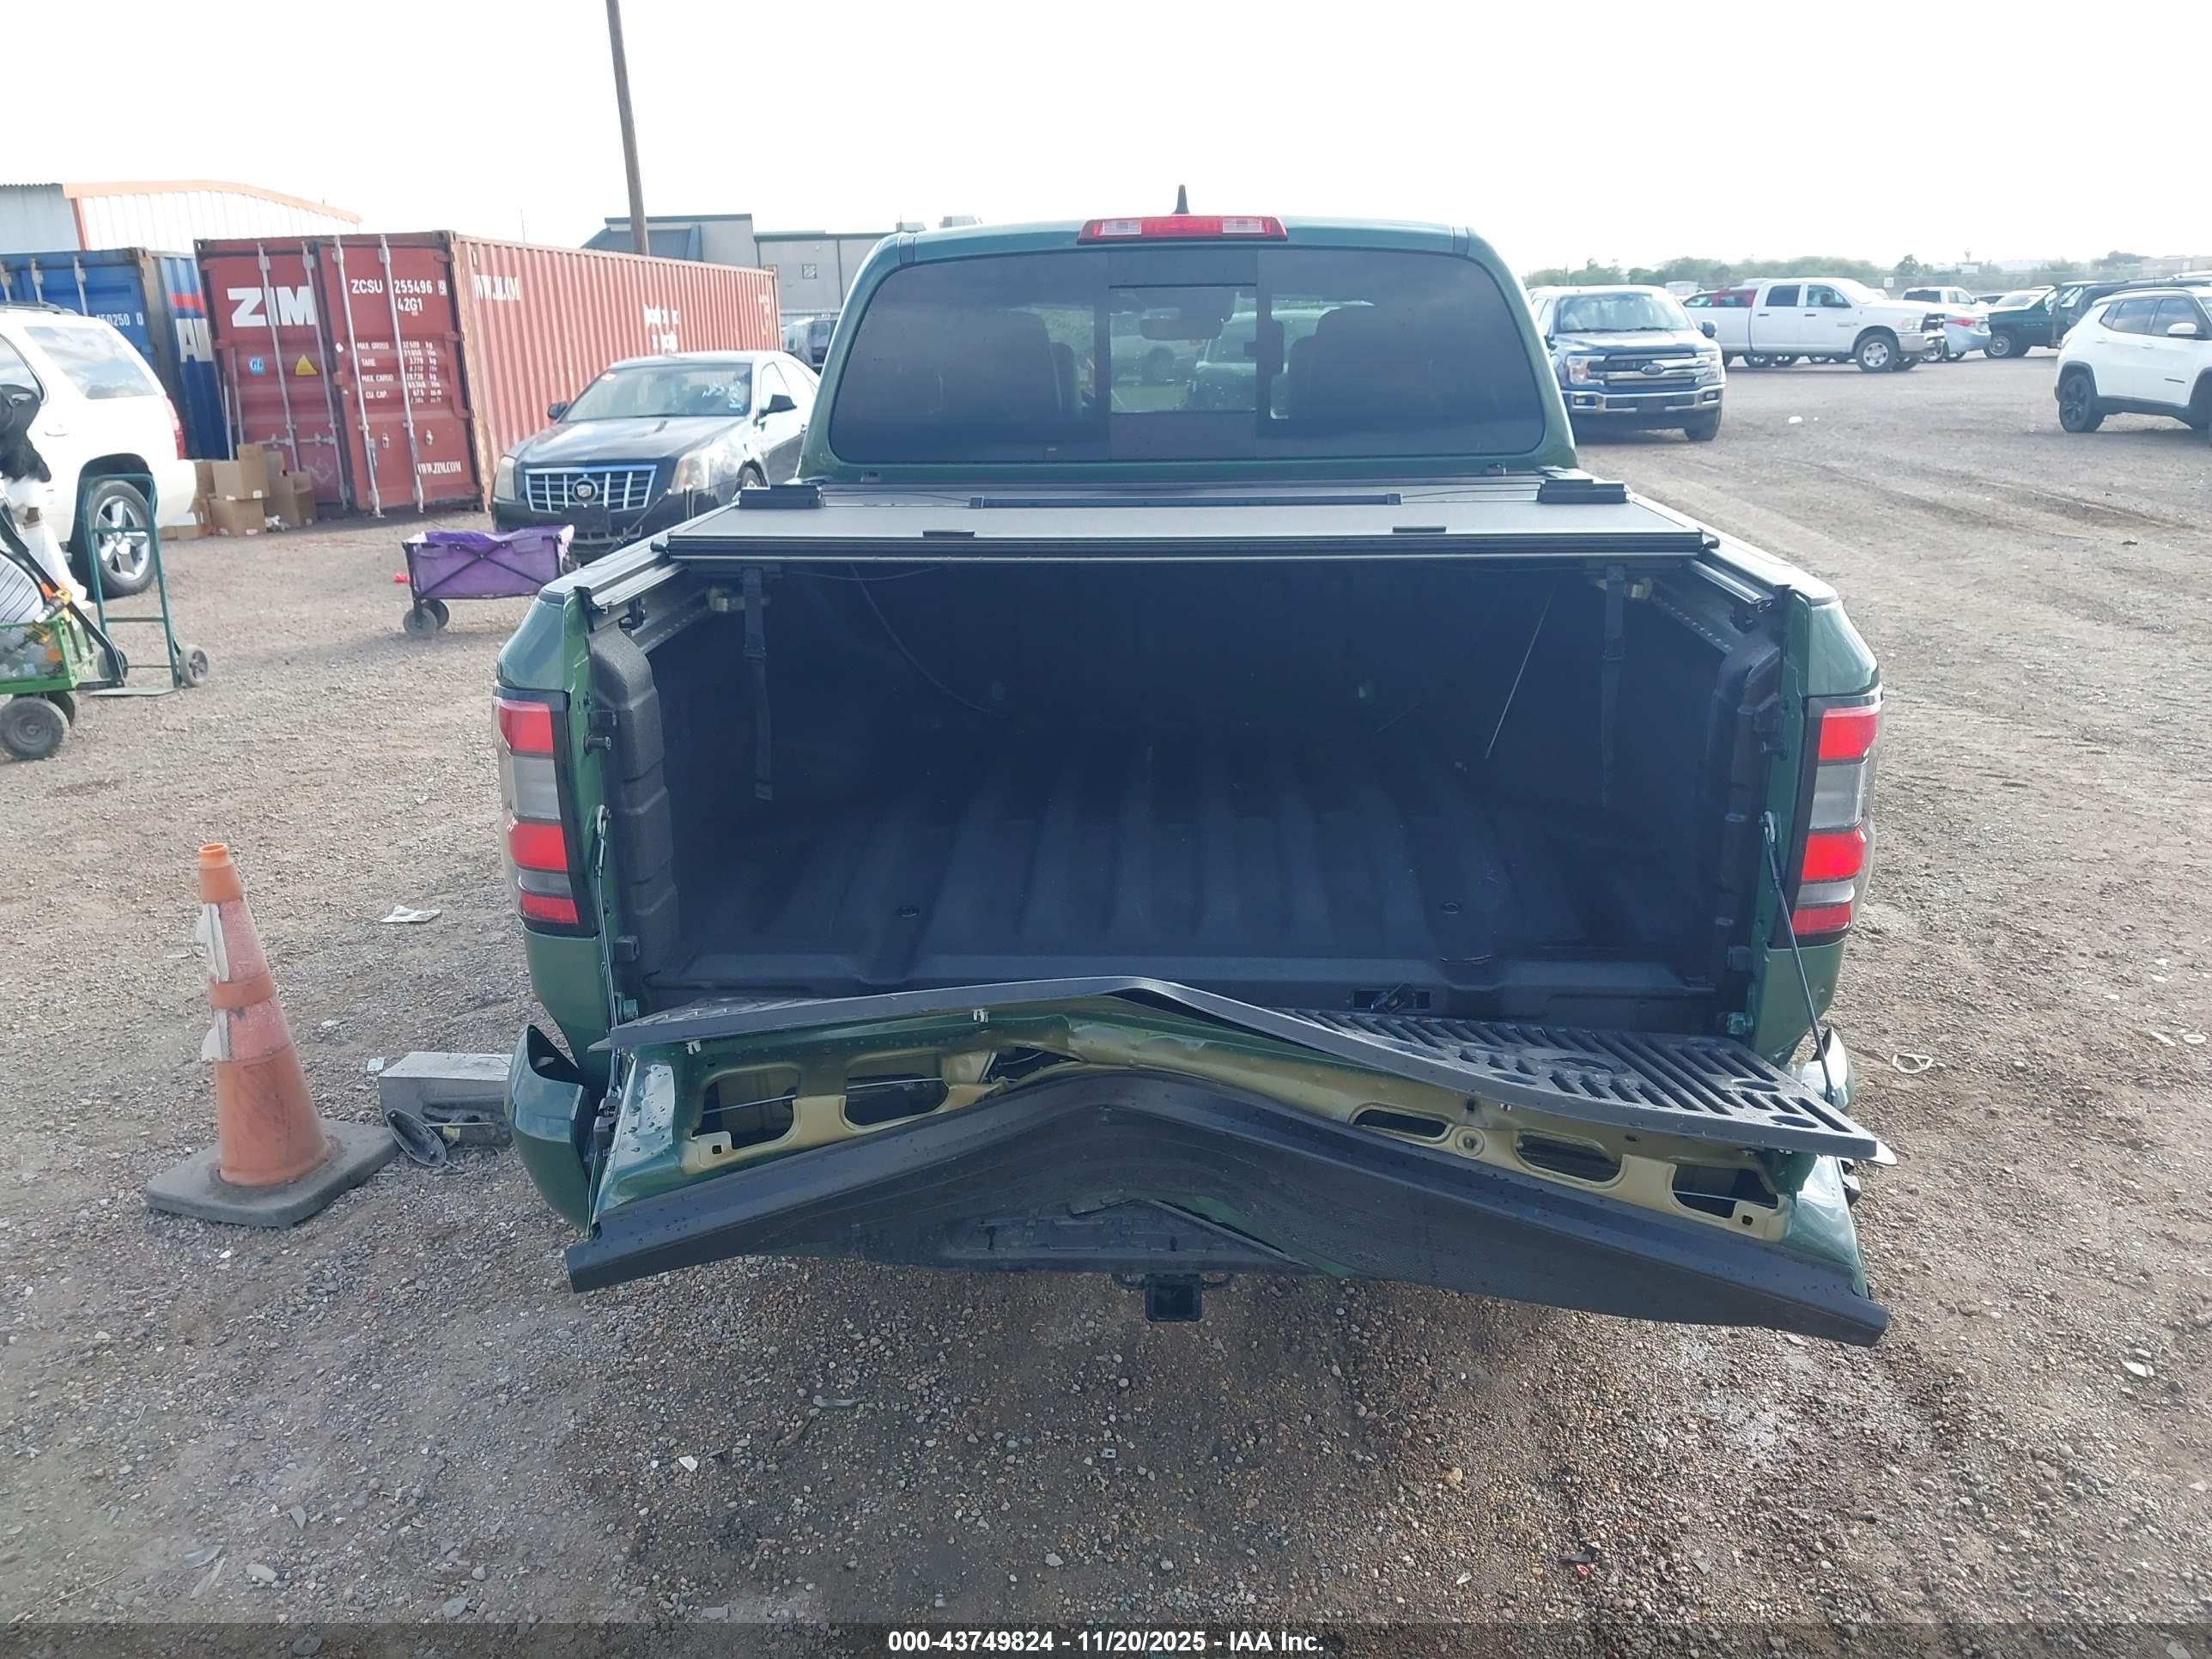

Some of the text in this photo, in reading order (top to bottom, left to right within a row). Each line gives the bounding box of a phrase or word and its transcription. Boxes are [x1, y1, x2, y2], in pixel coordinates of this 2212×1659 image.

[350, 279, 383, 295] ZCSU
[394, 278, 433, 294] 255496
[227, 285, 316, 327] ZIM
[398, 297, 423, 312] 42G1
